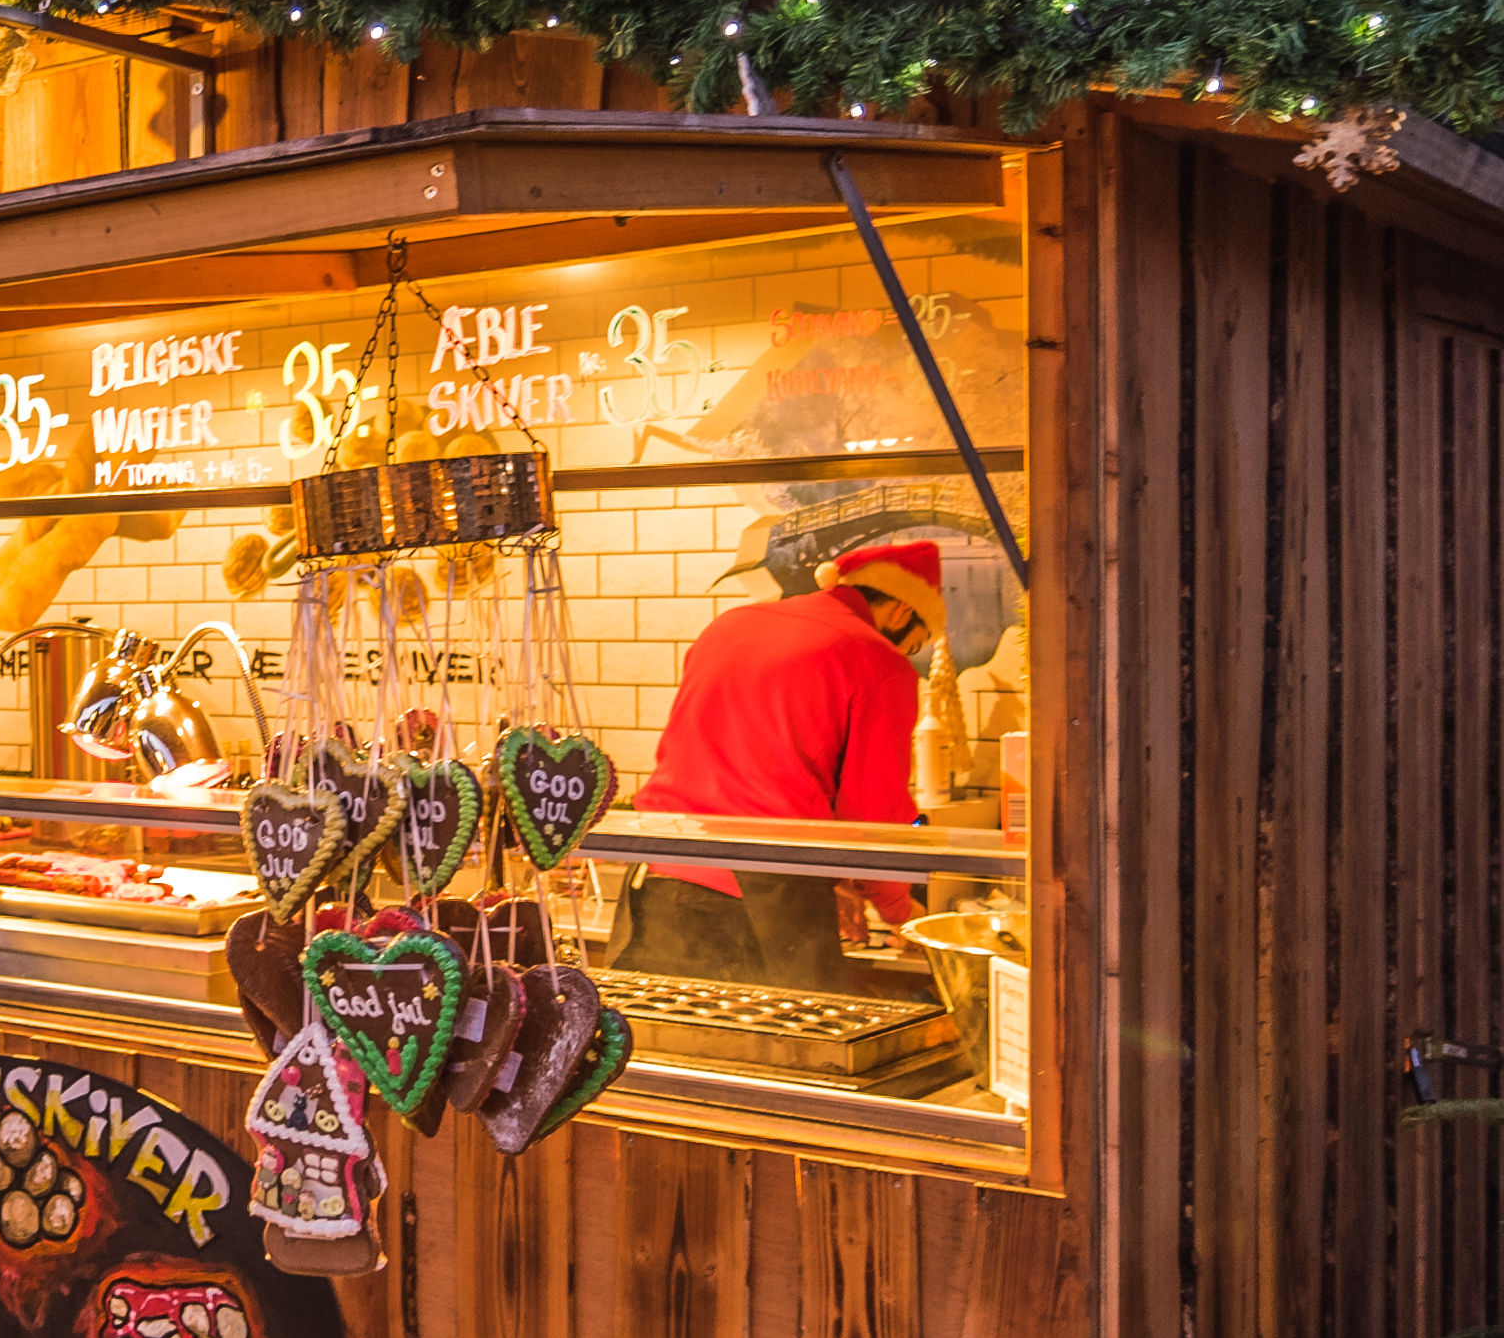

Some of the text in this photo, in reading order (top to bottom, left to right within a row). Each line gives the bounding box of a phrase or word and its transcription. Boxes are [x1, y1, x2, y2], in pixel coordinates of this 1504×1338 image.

[429, 304, 552, 374] ÆBLE
[528, 769, 587, 802] GOD
[533, 797, 573, 825] JUL
[255, 818, 309, 853] GOD
[259, 852, 301, 880] JUL
[328, 981, 385, 1022] God
